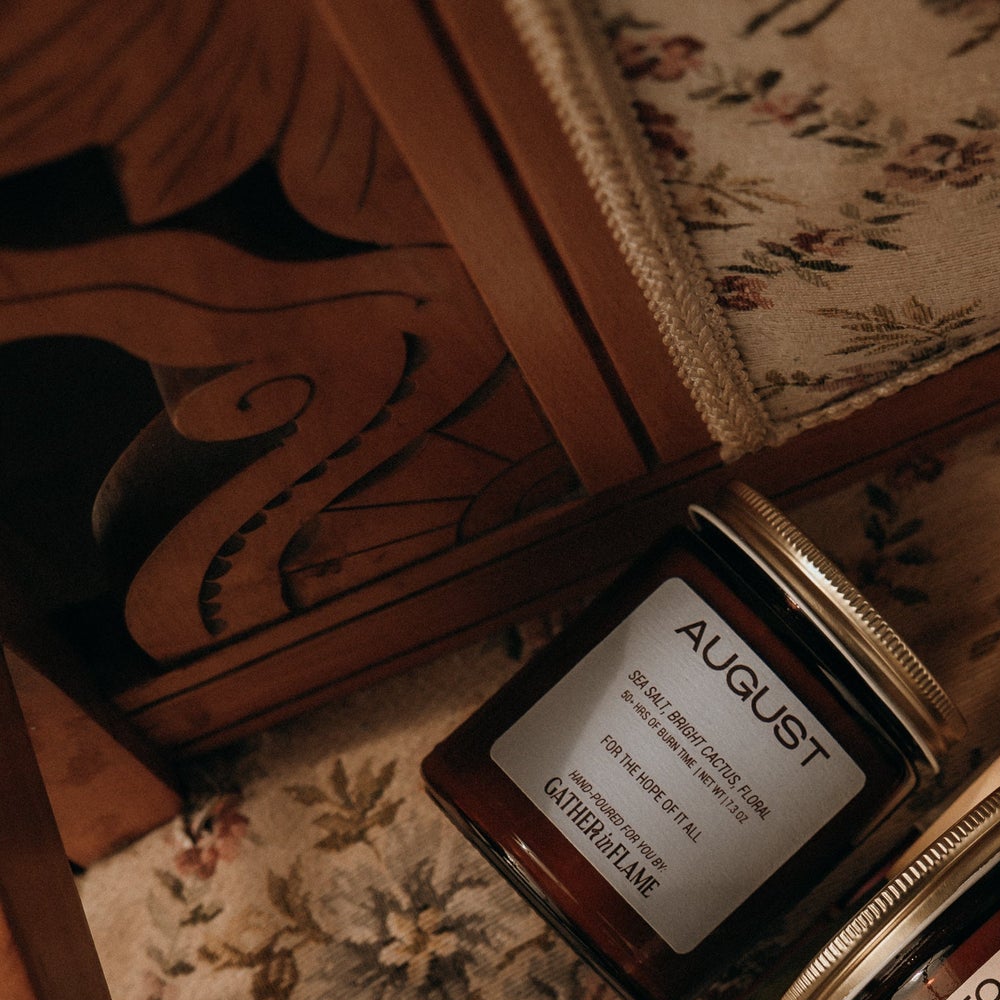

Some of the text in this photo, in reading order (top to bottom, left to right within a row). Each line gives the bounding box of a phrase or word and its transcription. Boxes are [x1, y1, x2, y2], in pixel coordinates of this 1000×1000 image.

[620, 689, 749, 825] 50+ HRS OF BURN TIME NET WT 7.3 OZ
[628, 669, 771, 821] SEA SALT, BRIGHT CACTUS, FLORAL
[674, 620, 831, 767] AUGUST
[543, 776, 661, 899] GATHER in FLAME
[568, 769, 668, 873] HAND-POURED FOR YOU BY:
[600, 734, 702, 844] FOR THE HOPE OF IT ALL
